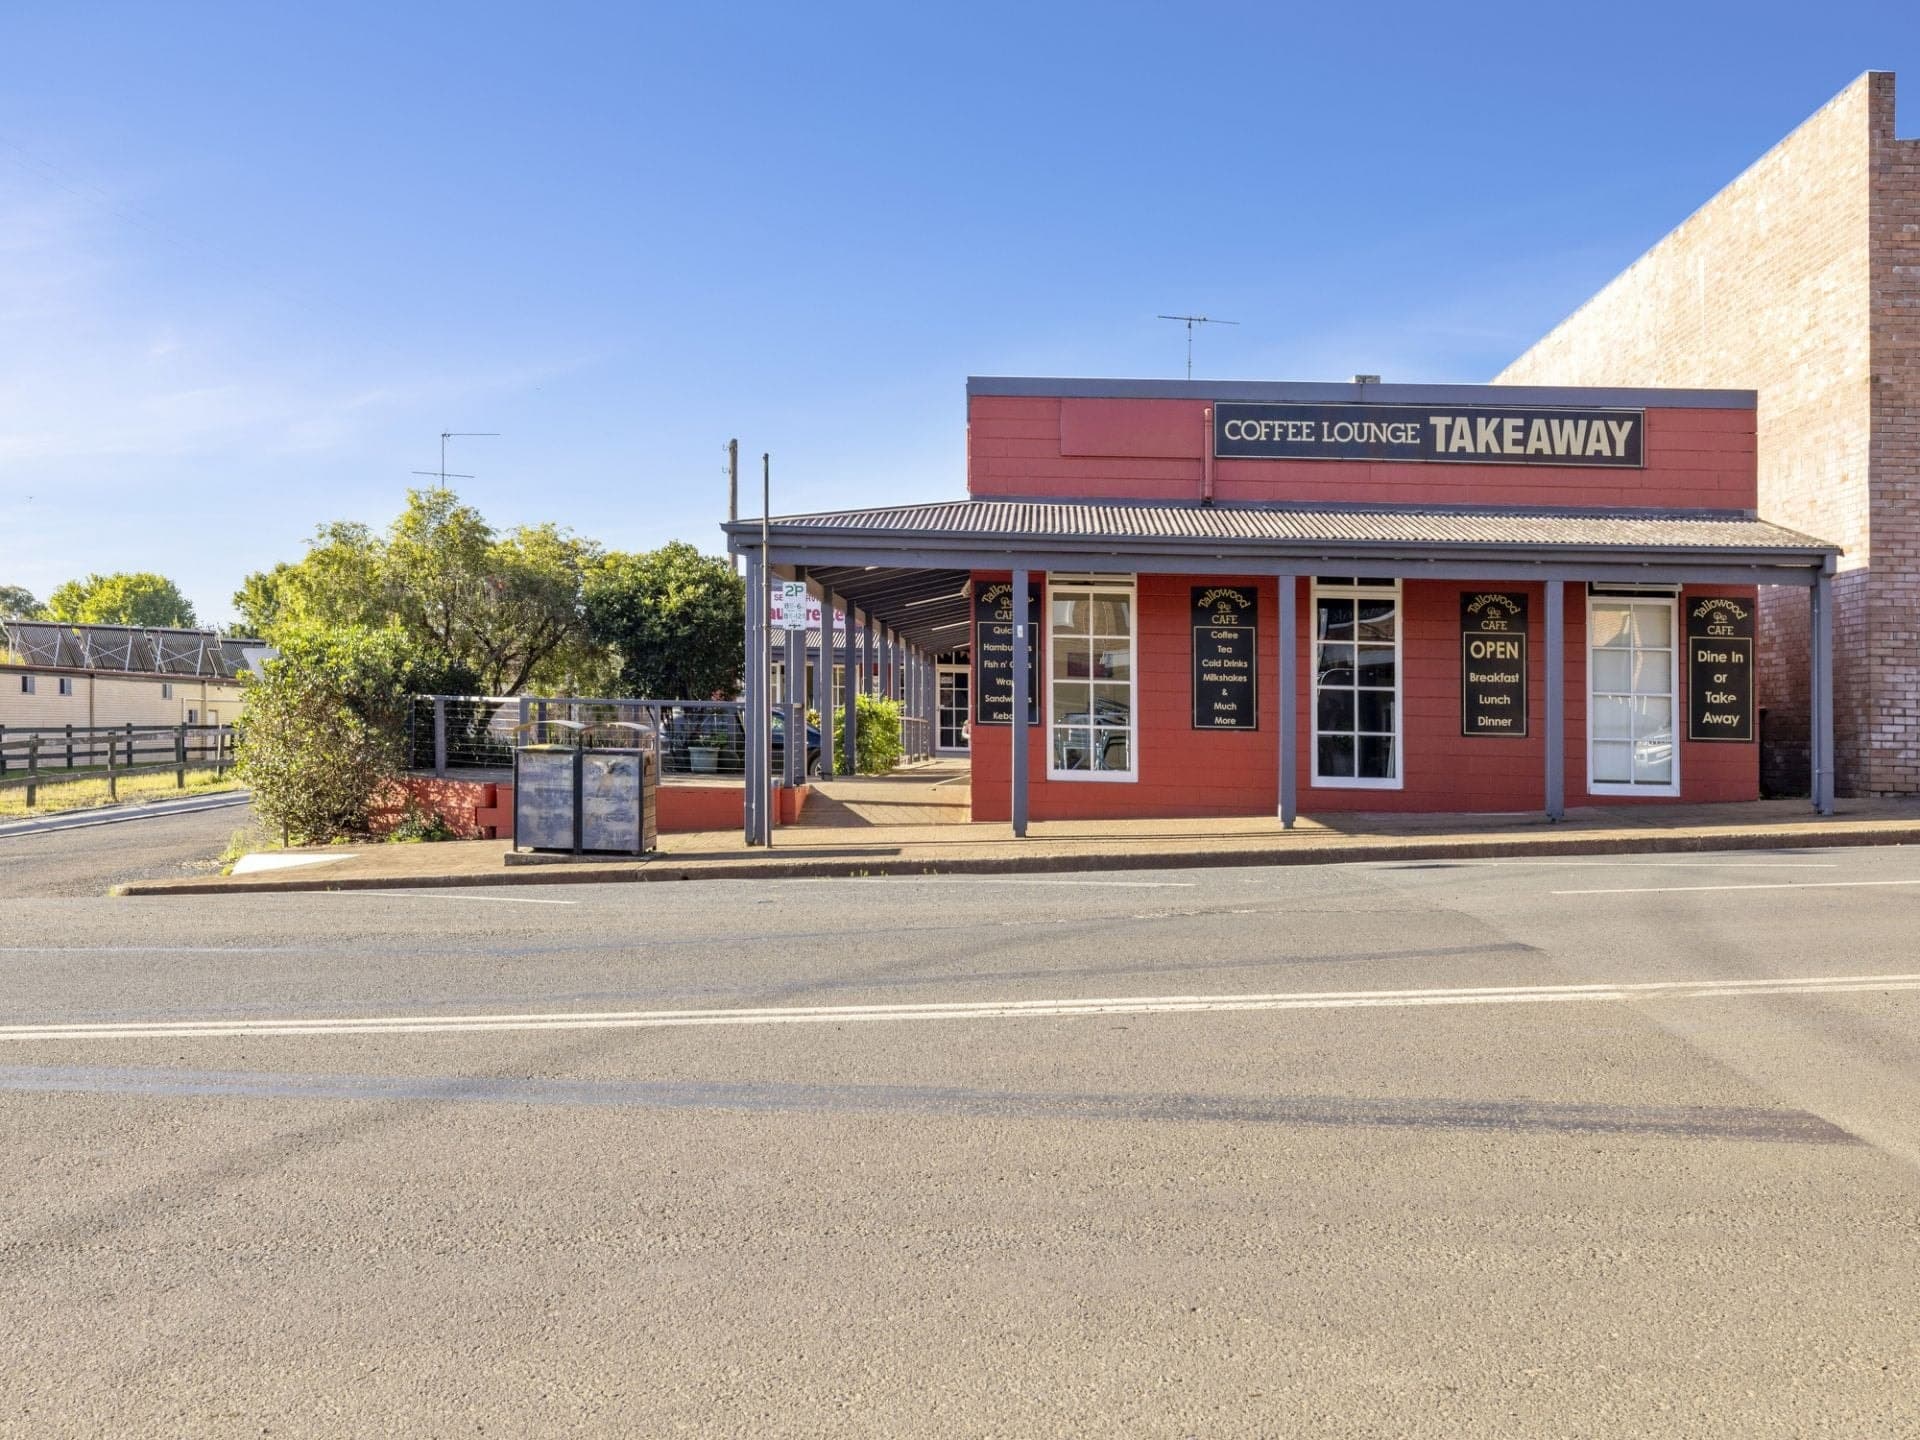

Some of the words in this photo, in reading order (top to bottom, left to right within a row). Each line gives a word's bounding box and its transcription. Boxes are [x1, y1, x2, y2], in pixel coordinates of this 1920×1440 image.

[1224, 419, 1315, 442] COFFEE
[1322, 421, 1420, 444] LOUNGE
[1429, 416, 1633, 457] TAKEAWAY
[785, 584, 804, 597] 2P
[1198, 589, 1250, 608] Tallowood
[1467, 594, 1521, 615] Tallowood
[994, 610, 1013, 620] CAF
[1693, 600, 1748, 620] Tallowood
[1211, 614, 1239, 624] CAFE
[1481, 620, 1508, 630] CAFE
[993, 626, 1013, 635] Quic
[1211, 631, 1239, 639] Coffee
[1707, 625, 1735, 636] CAFE
[983, 643, 1032, 652] Hambus
[1217, 645, 1233, 654] Tea
[1470, 640, 1519, 659] OPEN
[1697, 650, 1728, 663] Dine
[1731, 651, 1744, 663] In
[984, 660, 999, 669] Fish
[1202, 659, 1221, 668] Cold
[1223, 659, 1248, 668] Drinks
[996, 677, 1013, 686] Wra
[1203, 673, 1248, 682] Milkshakes
[1470, 672, 1520, 683] Breakfast
[1713, 673, 1728, 684] or
[1222, 688, 1228, 696] &
[1479, 694, 1511, 705] Lunch
[1704, 691, 1737, 704] Take
[1214, 702, 1237, 710] Much
[993, 712, 1013, 720] Keba
[1215, 716, 1237, 725] More
[1477, 715, 1513, 727] Dinner
[1702, 711, 1740, 727] Away
